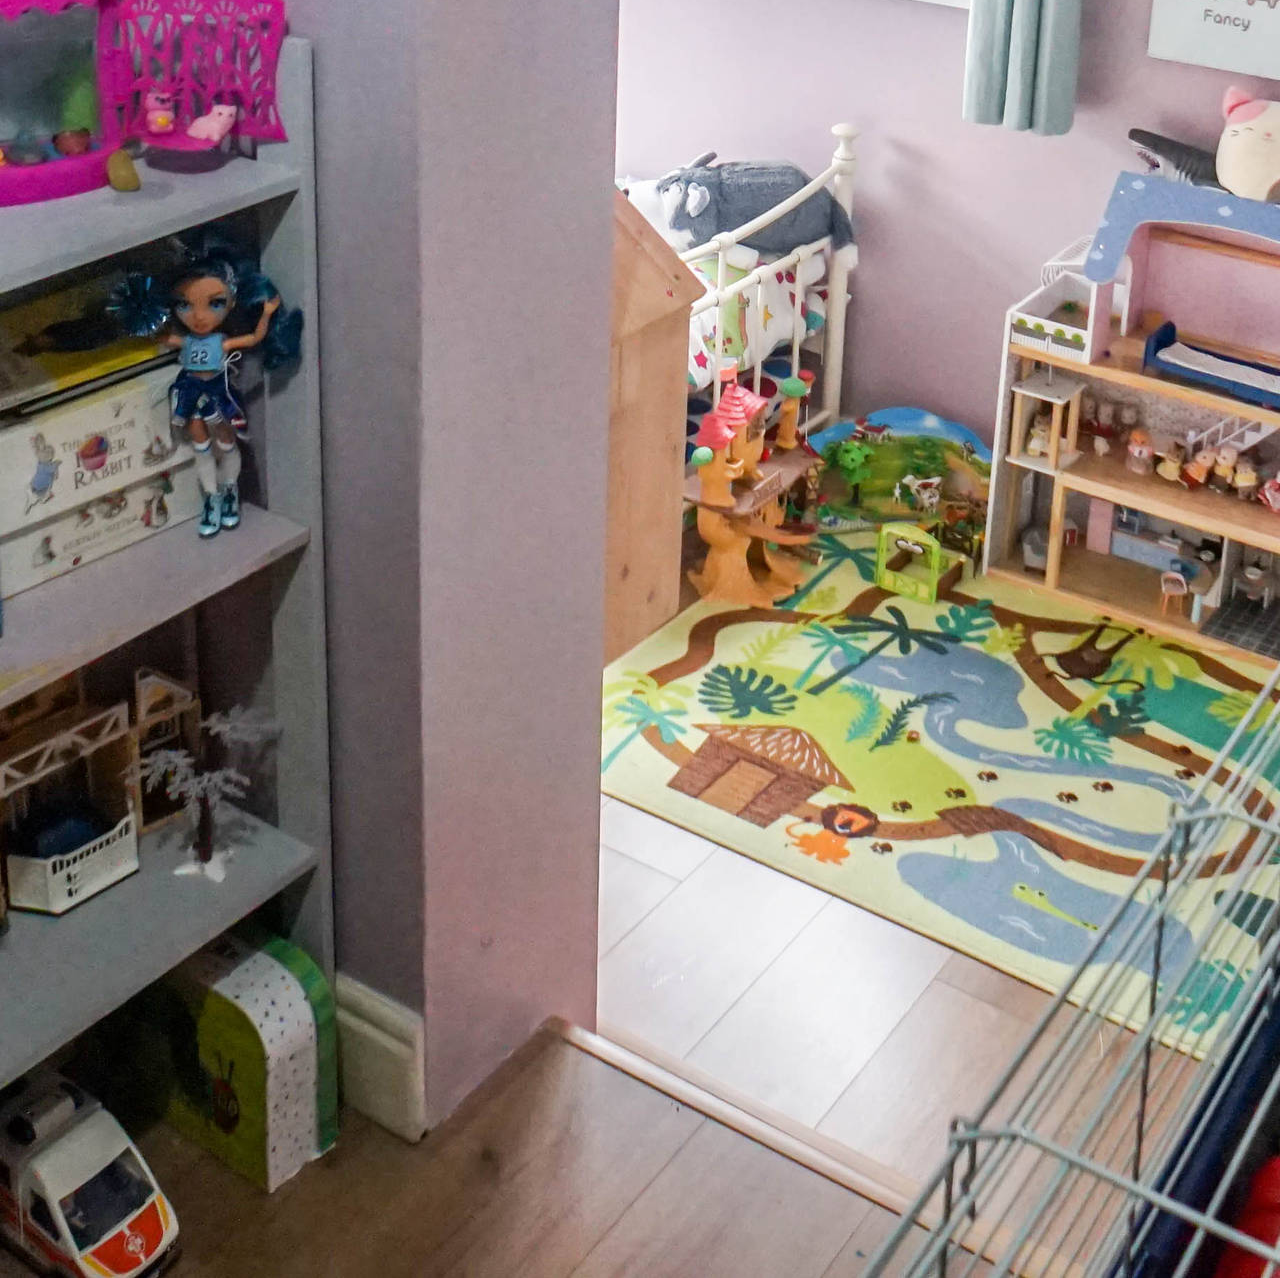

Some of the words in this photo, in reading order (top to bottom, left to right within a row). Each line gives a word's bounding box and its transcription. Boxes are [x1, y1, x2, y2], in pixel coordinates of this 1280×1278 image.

[1203, 8, 1252, 32] Fancy
[191, 350, 209, 364] 22
[74, 454, 133, 490] RABBIT
